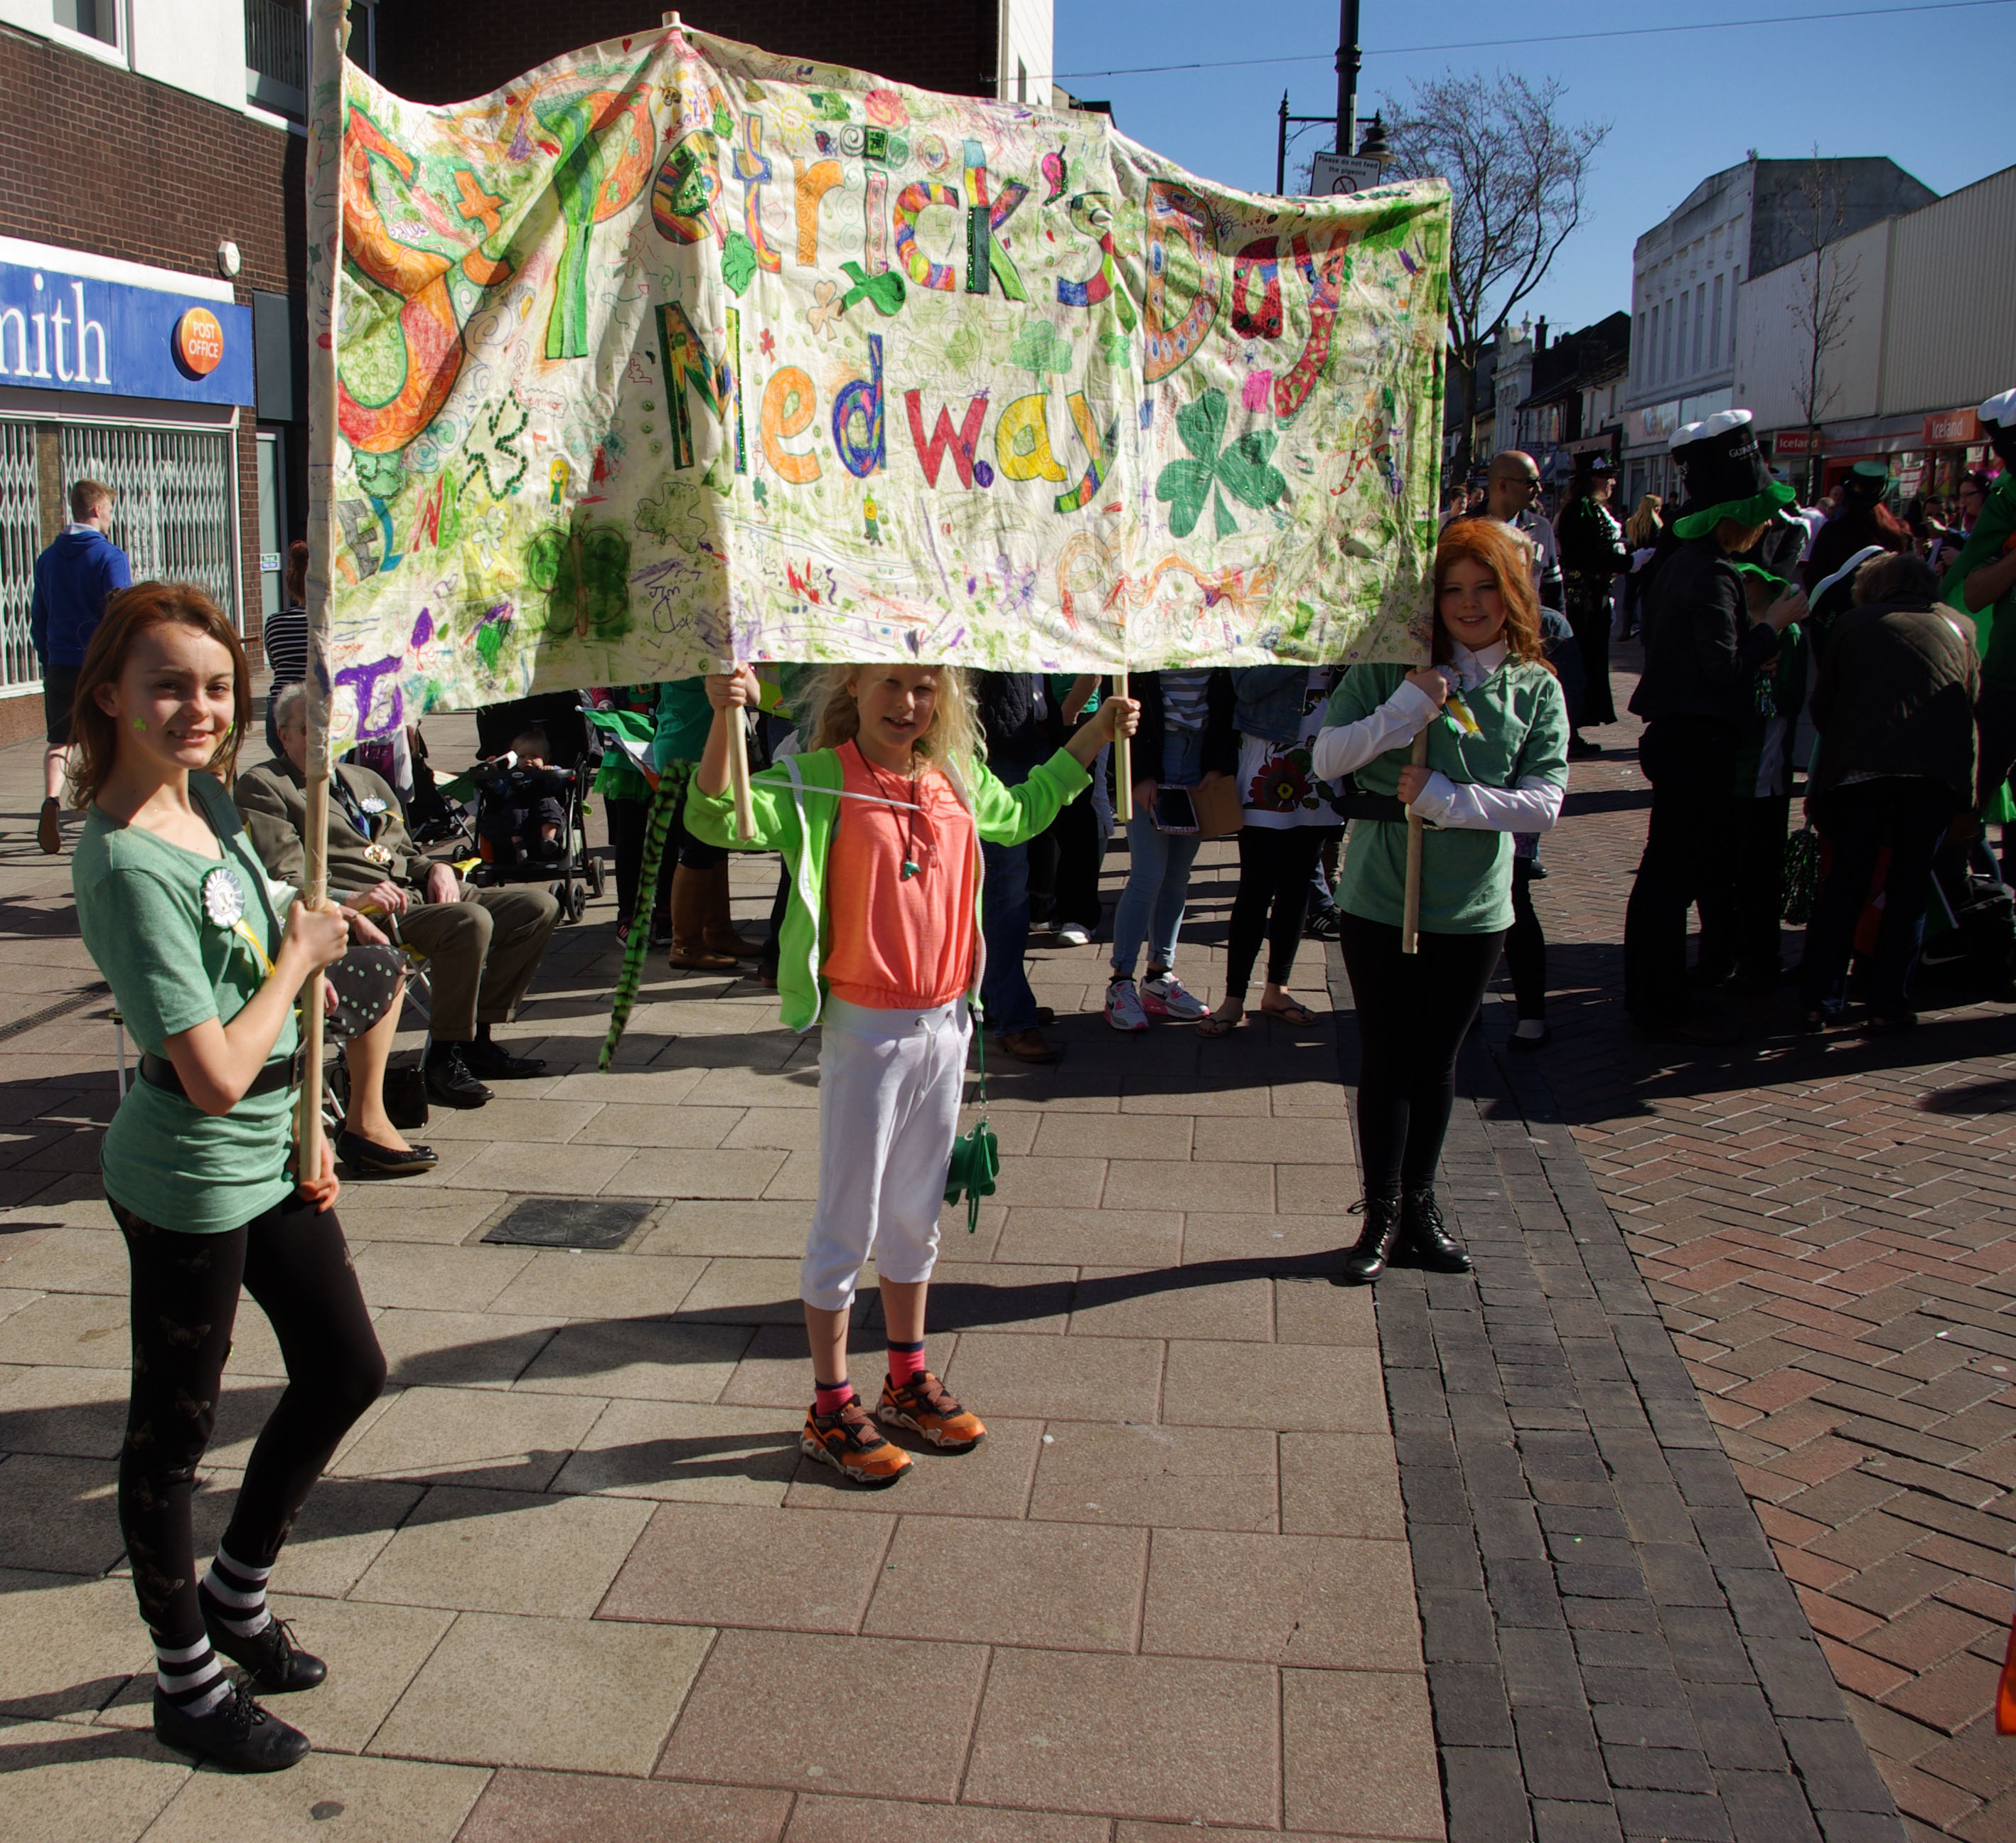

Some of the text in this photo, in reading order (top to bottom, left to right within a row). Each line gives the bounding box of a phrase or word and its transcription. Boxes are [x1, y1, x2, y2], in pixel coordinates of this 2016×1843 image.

[1317, 155, 1339, 165] Please
[1351, 159, 1362, 167] not
[1363, 159, 1378, 169] feed
[1341, 167, 1366, 176] pigeons
[1144, 177, 1351, 429] Day
[193, 320, 215, 339] POST
[188, 338, 220, 359] OFFICE
[654, 299, 1121, 515] Medway
[1931, 418, 1964, 440] Iceland
[1779, 437, 1818, 449] Iceland
